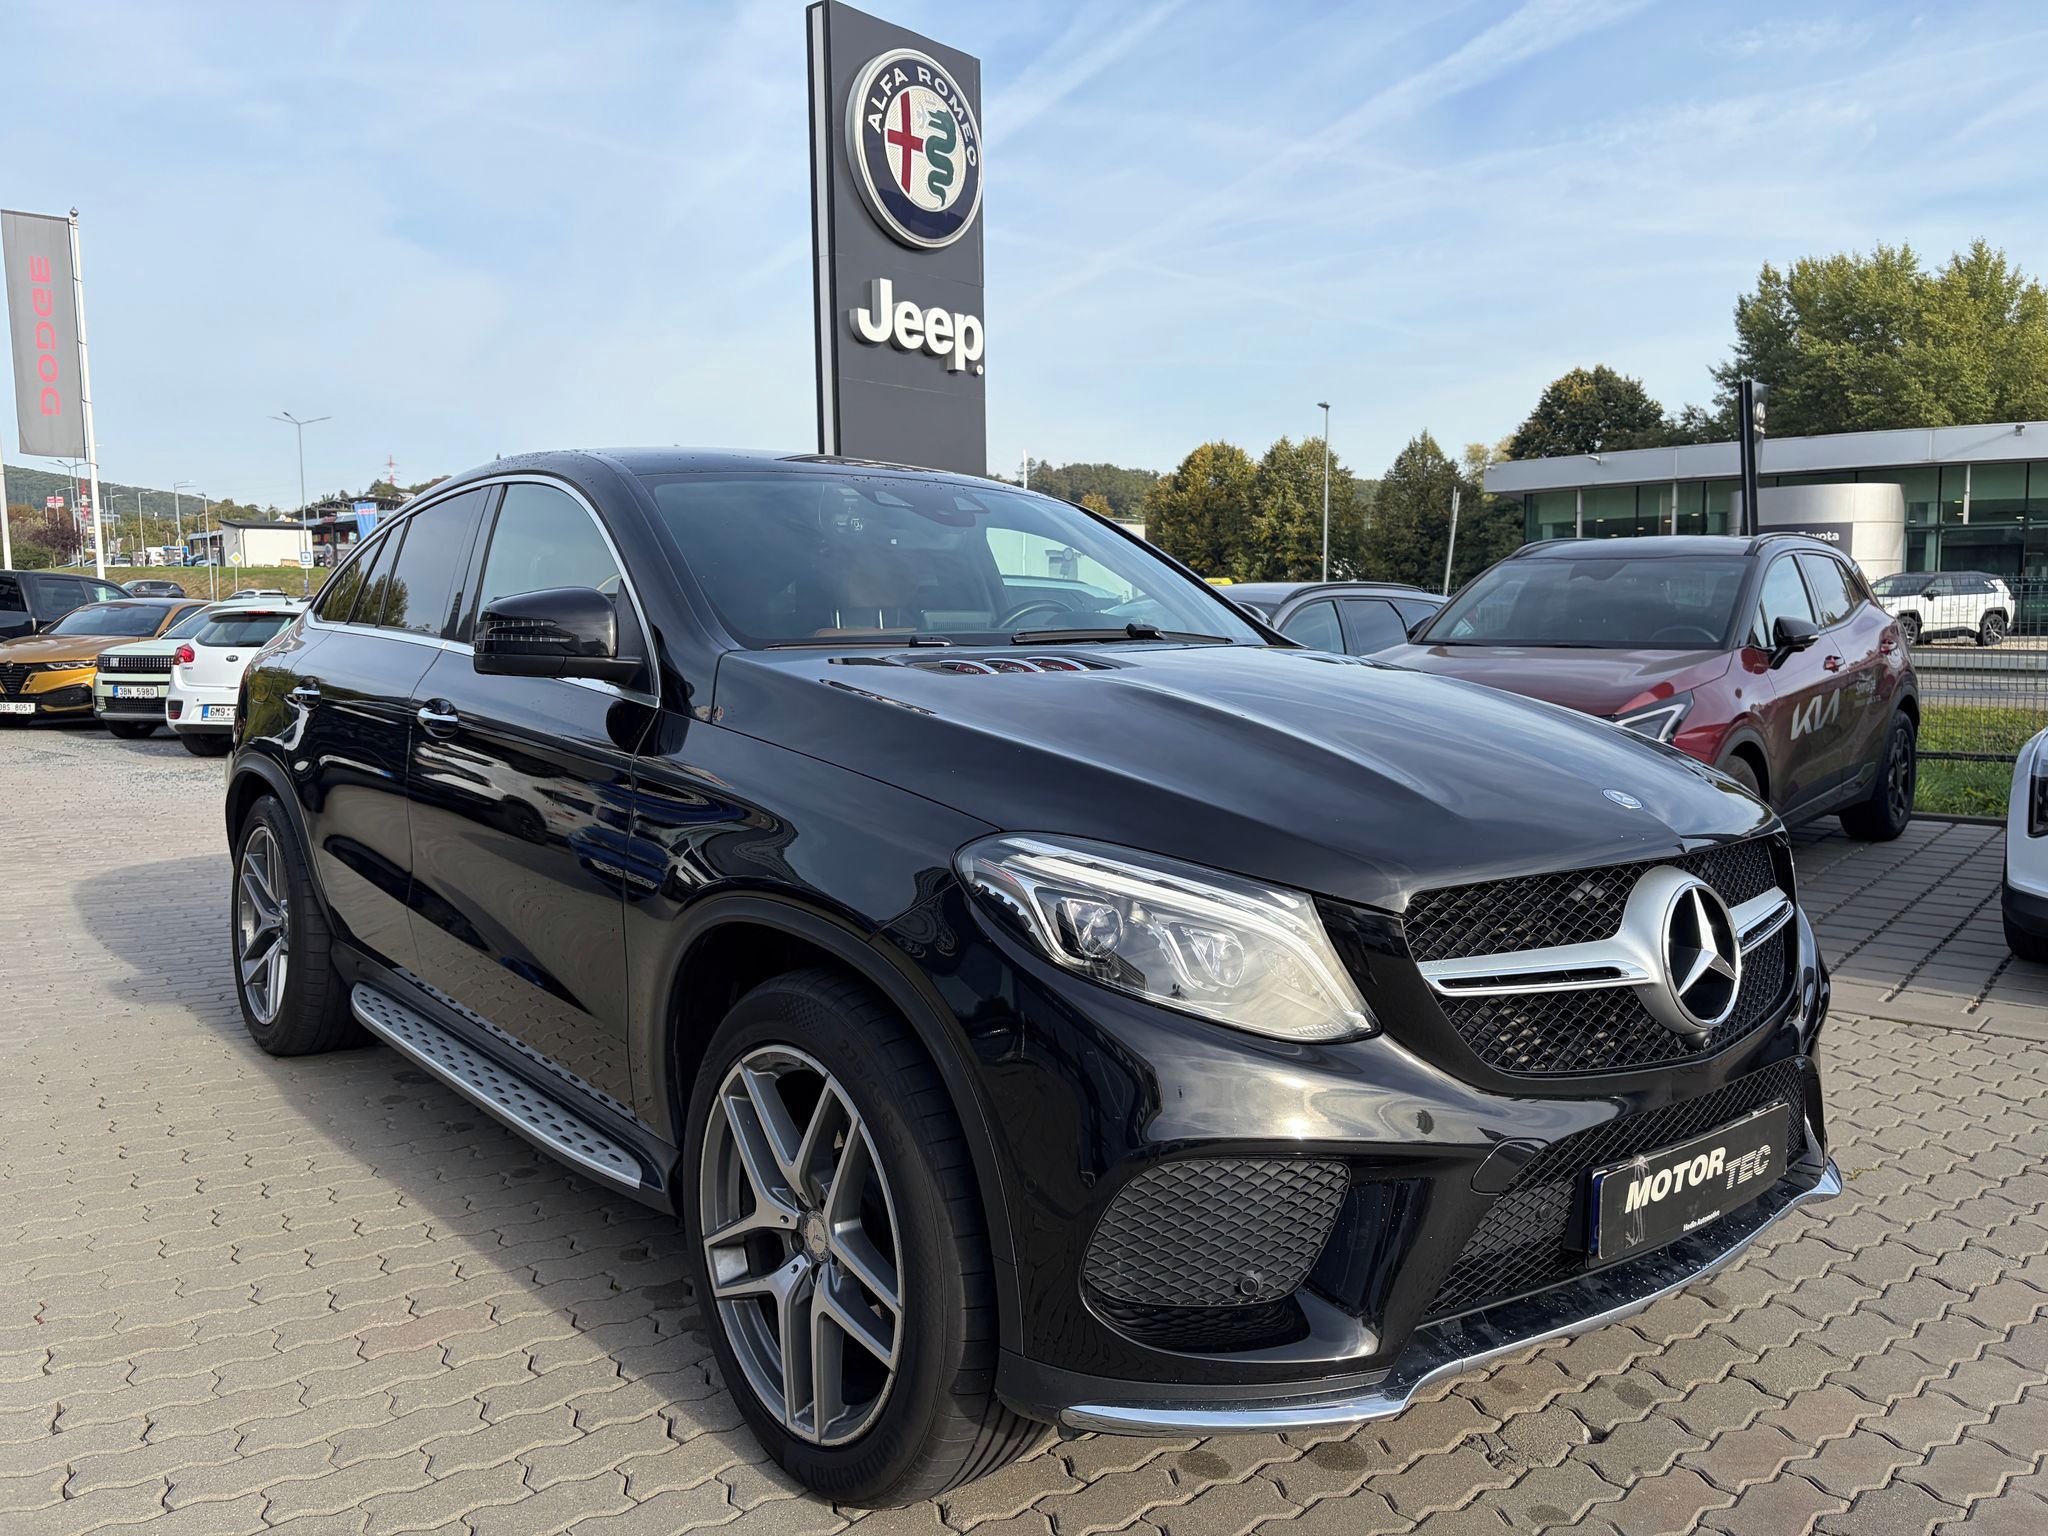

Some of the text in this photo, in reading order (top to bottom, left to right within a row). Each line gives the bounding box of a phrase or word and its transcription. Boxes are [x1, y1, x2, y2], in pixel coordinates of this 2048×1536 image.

[867, 65, 978, 167] ALFA ROMEO
[29, 255, 61, 417] DODGE
[855, 278, 984, 371] Jeep
[1797, 530, 1840, 541] Tyota
